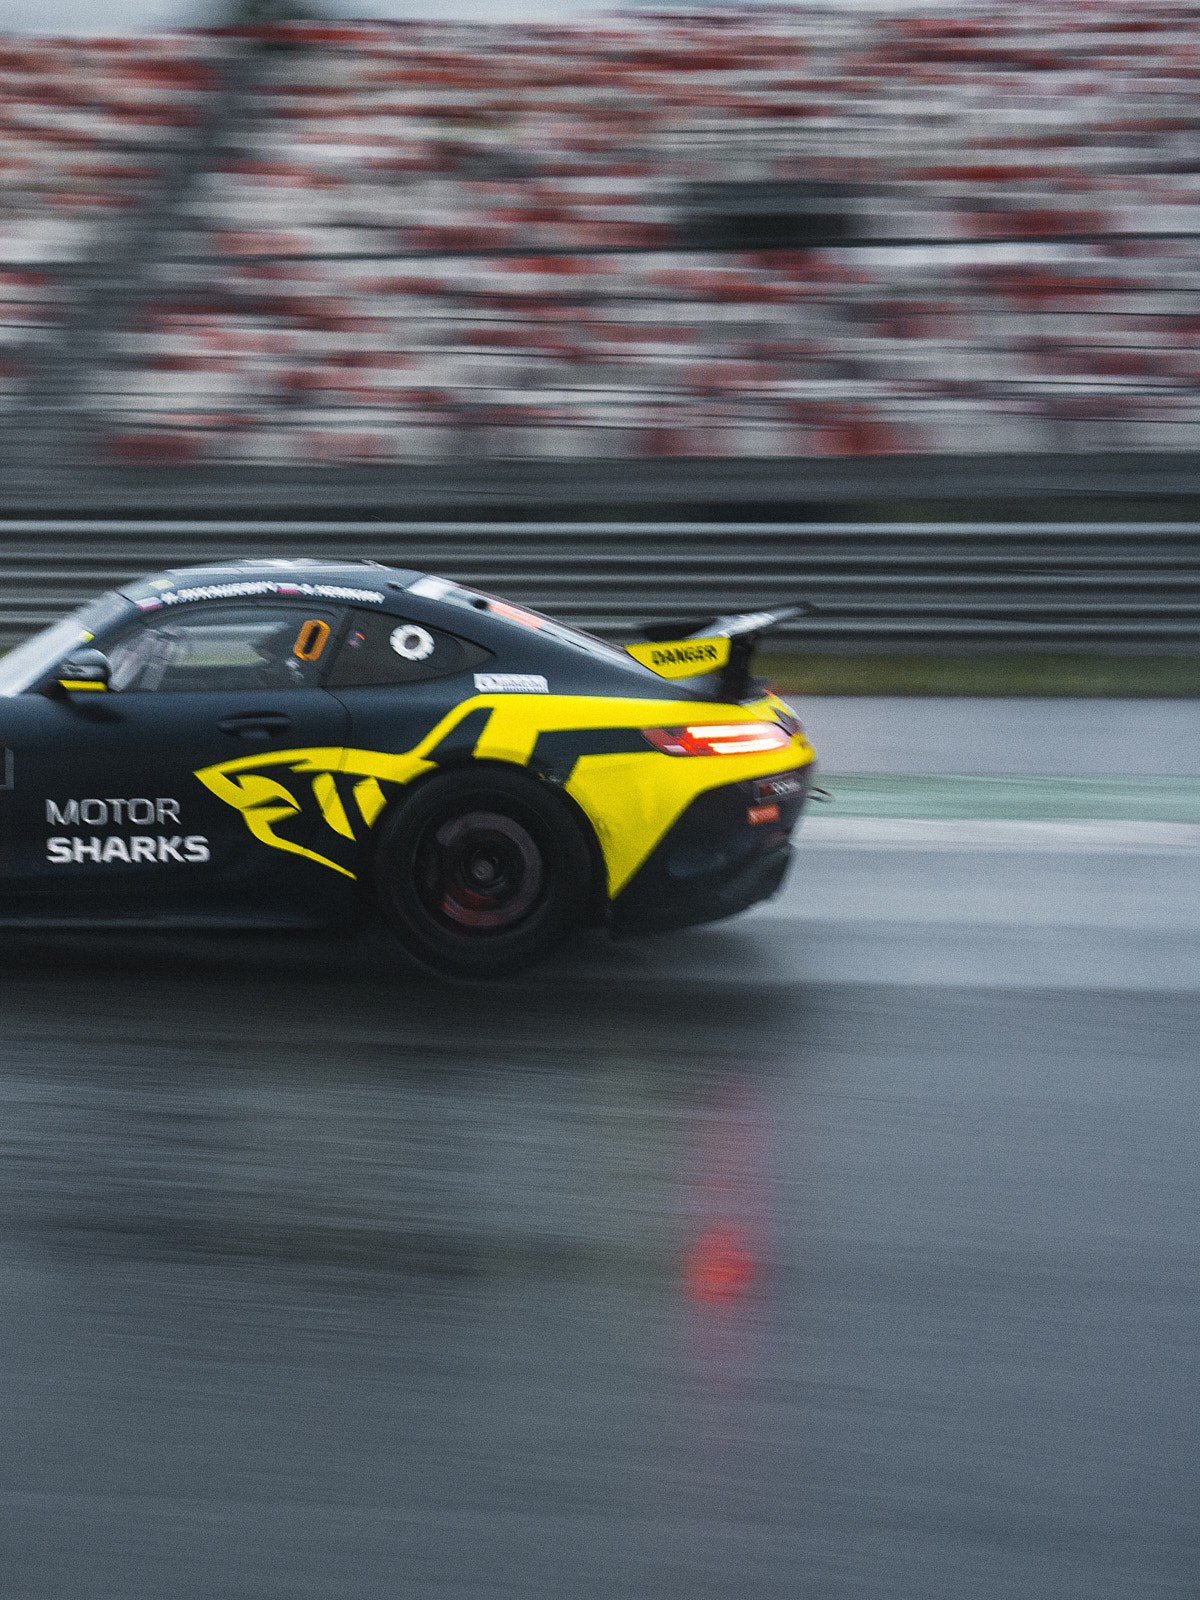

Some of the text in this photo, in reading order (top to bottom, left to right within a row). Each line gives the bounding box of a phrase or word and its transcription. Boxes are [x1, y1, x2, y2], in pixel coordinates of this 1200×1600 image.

[651, 645, 717, 666] DANGER
[45, 797, 181, 826] MOTOR
[46, 835, 210, 864] SHARKS
